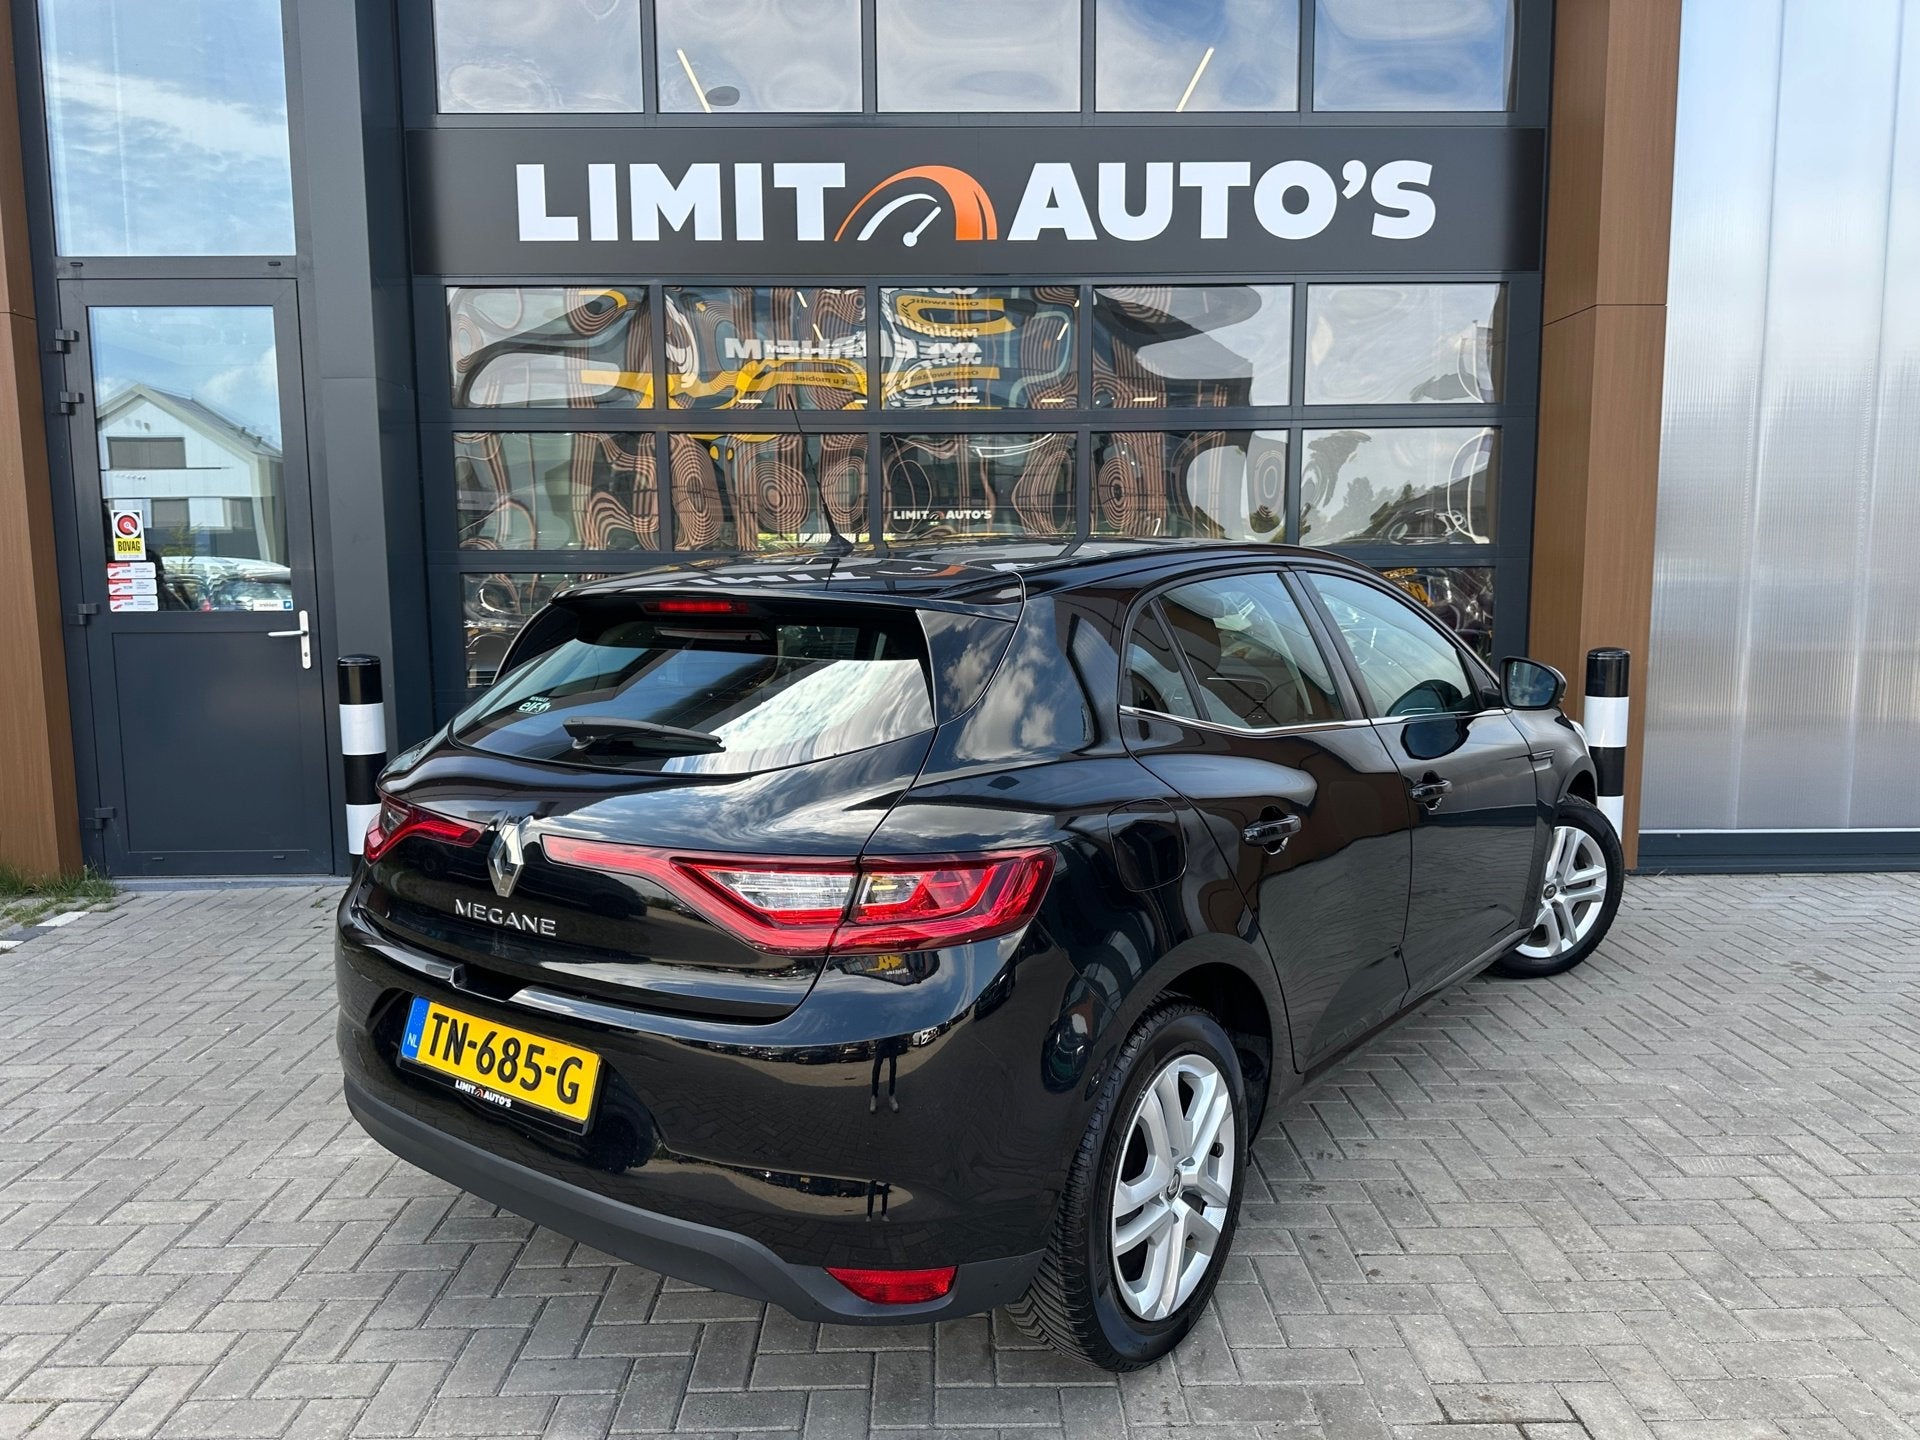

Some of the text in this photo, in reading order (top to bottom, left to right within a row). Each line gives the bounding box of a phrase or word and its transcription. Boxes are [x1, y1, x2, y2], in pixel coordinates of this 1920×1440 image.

[516, 159, 1436, 241] LIMIT AUTO'S
[893, 510, 992, 520] LIMIT AUTO'S
[117, 540, 141, 552] BOVAG
[455, 898, 557, 937] MEGANE
[406, 1033, 418, 1048] NL
[428, 1012, 583, 1105] TN-685-G
[455, 1079, 512, 1108] LIMIT AUTO'S
